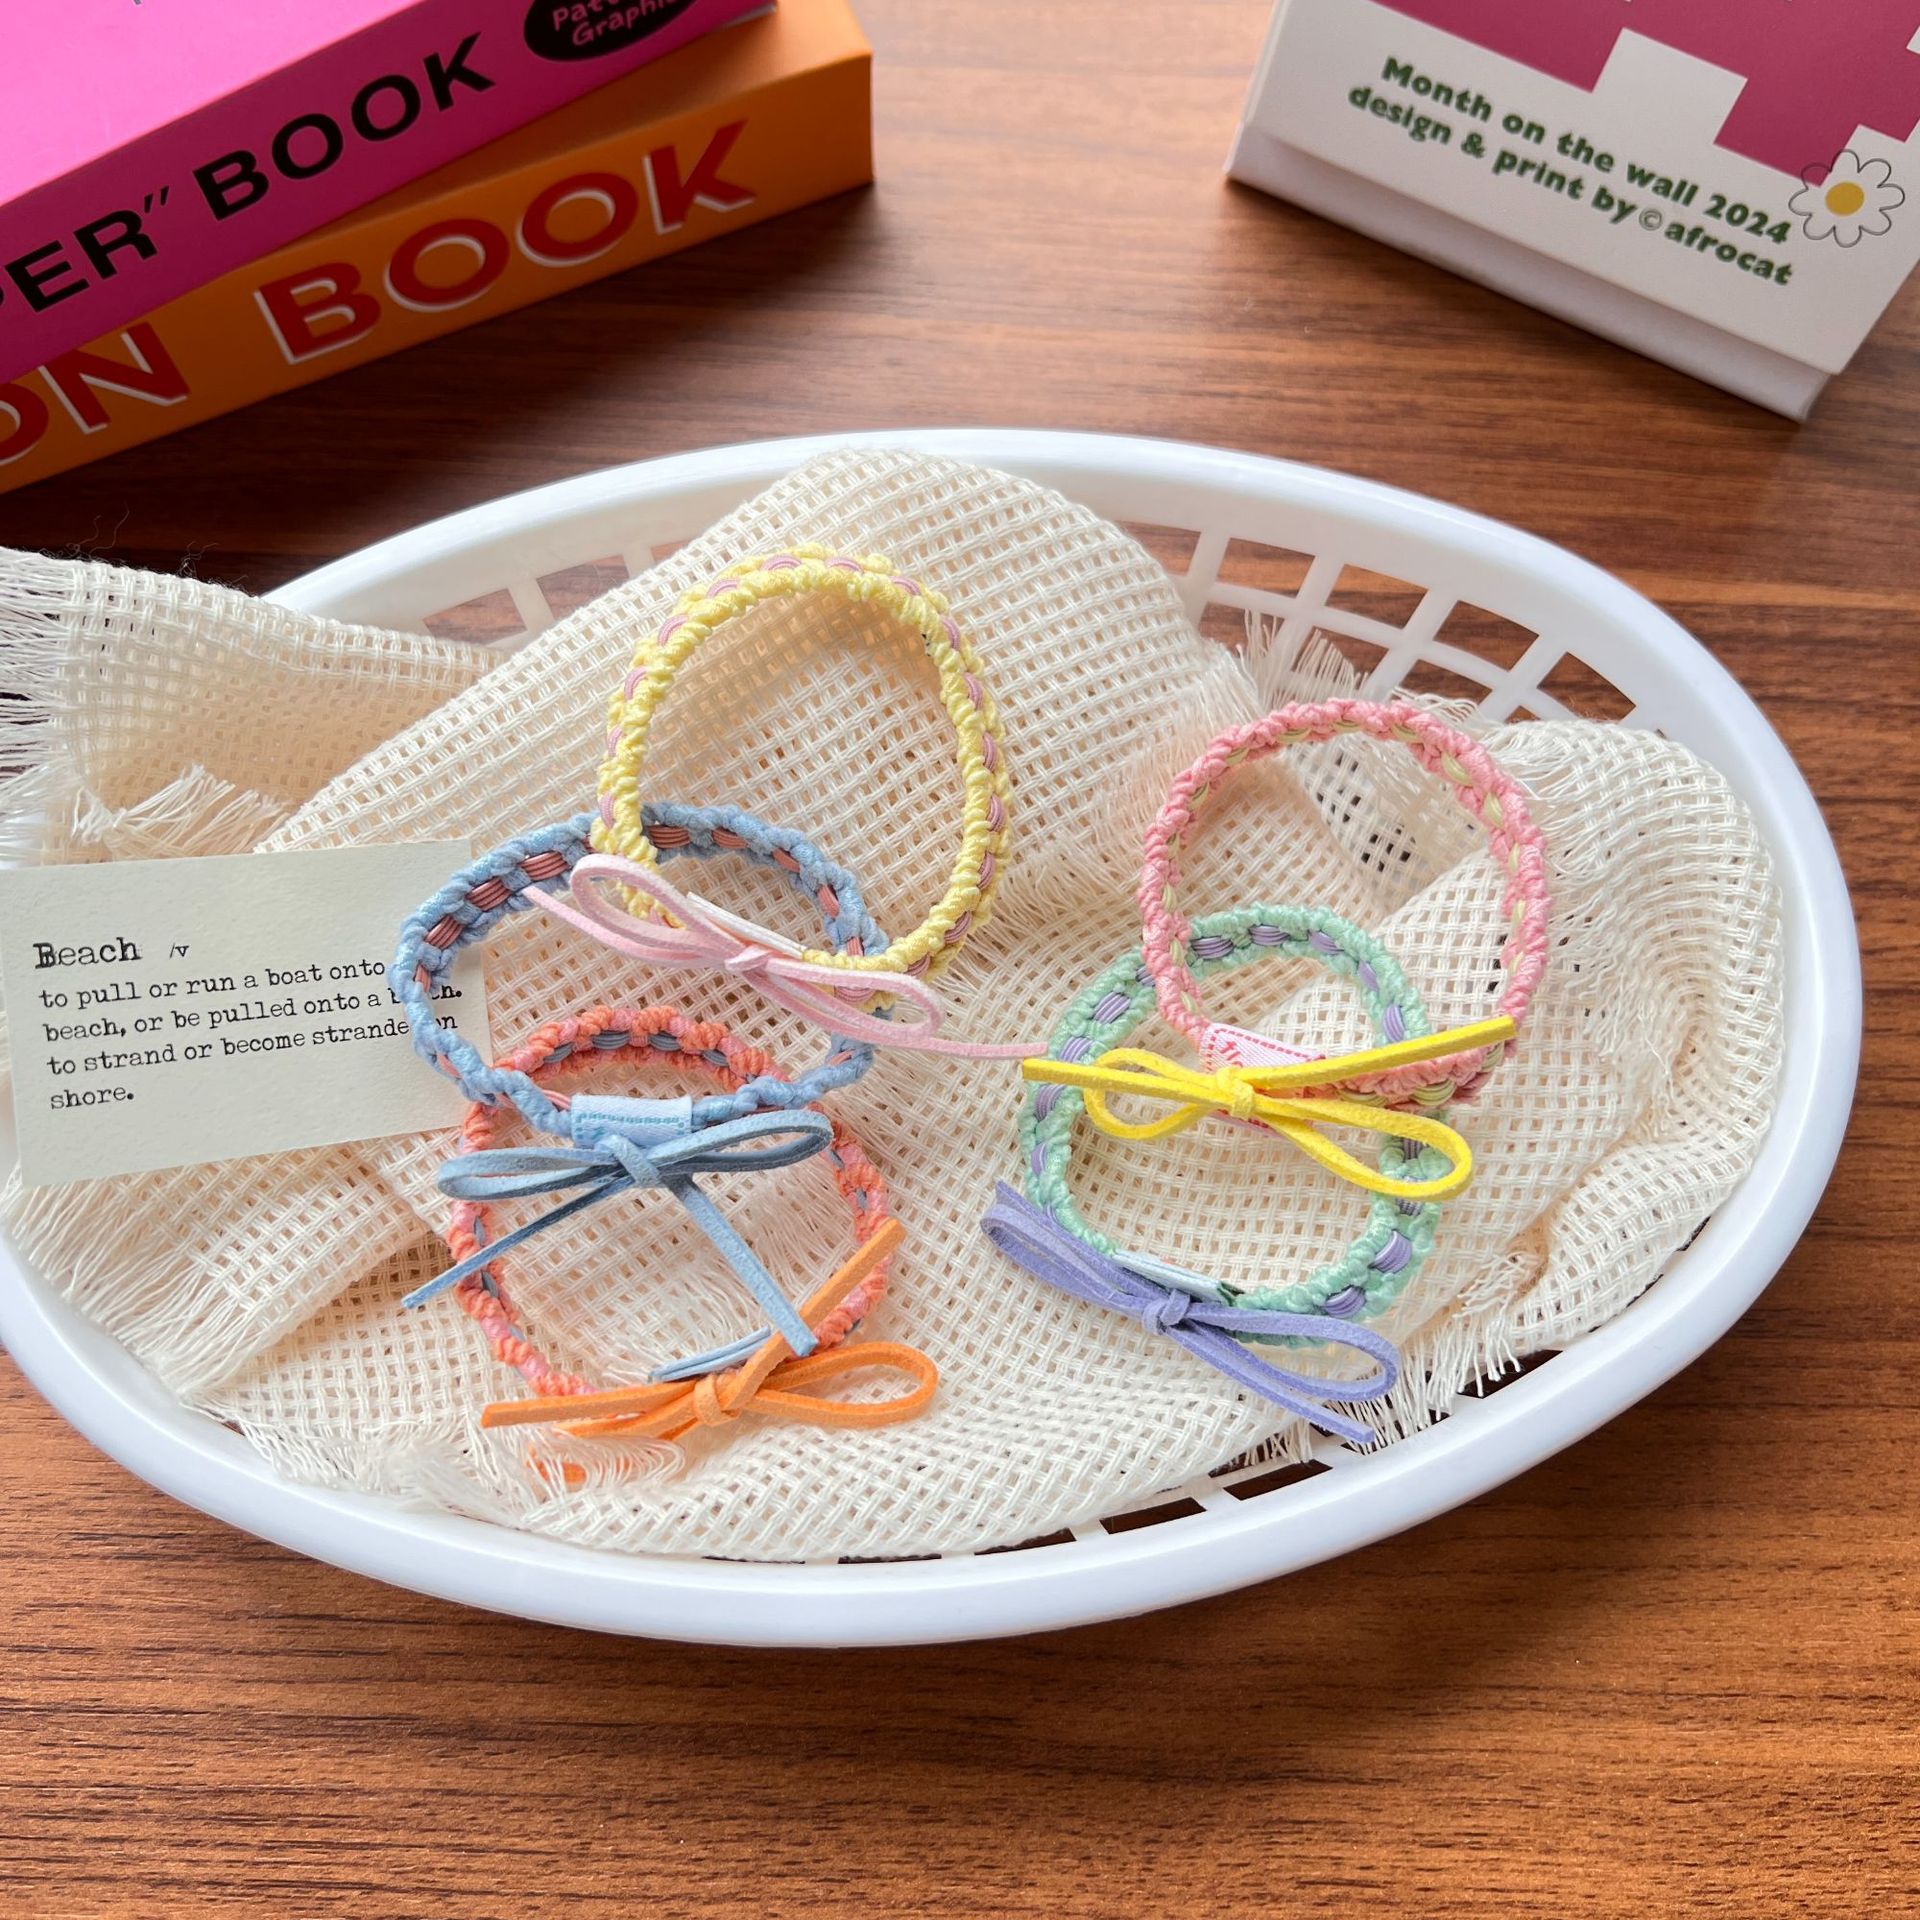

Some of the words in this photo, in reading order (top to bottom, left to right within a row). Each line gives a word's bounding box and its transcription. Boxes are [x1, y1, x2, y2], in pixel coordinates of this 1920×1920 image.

[1348, 86, 1452, 145] design
[1461, 131, 1487, 159] &
[1491, 149, 1584, 200] print
[1381, 56, 1493, 122] Month
[1502, 113, 1546, 145] on
[1557, 130, 1615, 174] the
[1626, 162, 1699, 207] wall
[1703, 193, 1792, 244] 2024
[0, 185, 169, 312] ER"
[193, 32, 497, 220] BOOK
[254, 118, 757, 365] BOOK
[33, 937, 143, 969] Beach
[39, 989, 68, 1008] to
[76, 981, 142, 1010] pull
[149, 981, 178, 998] or
[186, 976, 237, 995] run
[244, 975, 259, 989] a
[265, 964, 322, 986] boat
[329, 959, 385, 980] onto
[43, 1018, 127, 1042] beach,
[134, 1016, 163, 1033] or
[171, 1010, 201, 1028] be
[208, 998, 297, 1029] pulled
[304, 992, 360, 1015] onto
[368, 993, 382, 1007] a
[47, 1056, 76, 1075] to
[84, 1044, 177, 1072] strand
[184, 1043, 213, 1060] or
[220, 1033, 306, 1056] become
[51, 1086, 134, 1110] shore.
